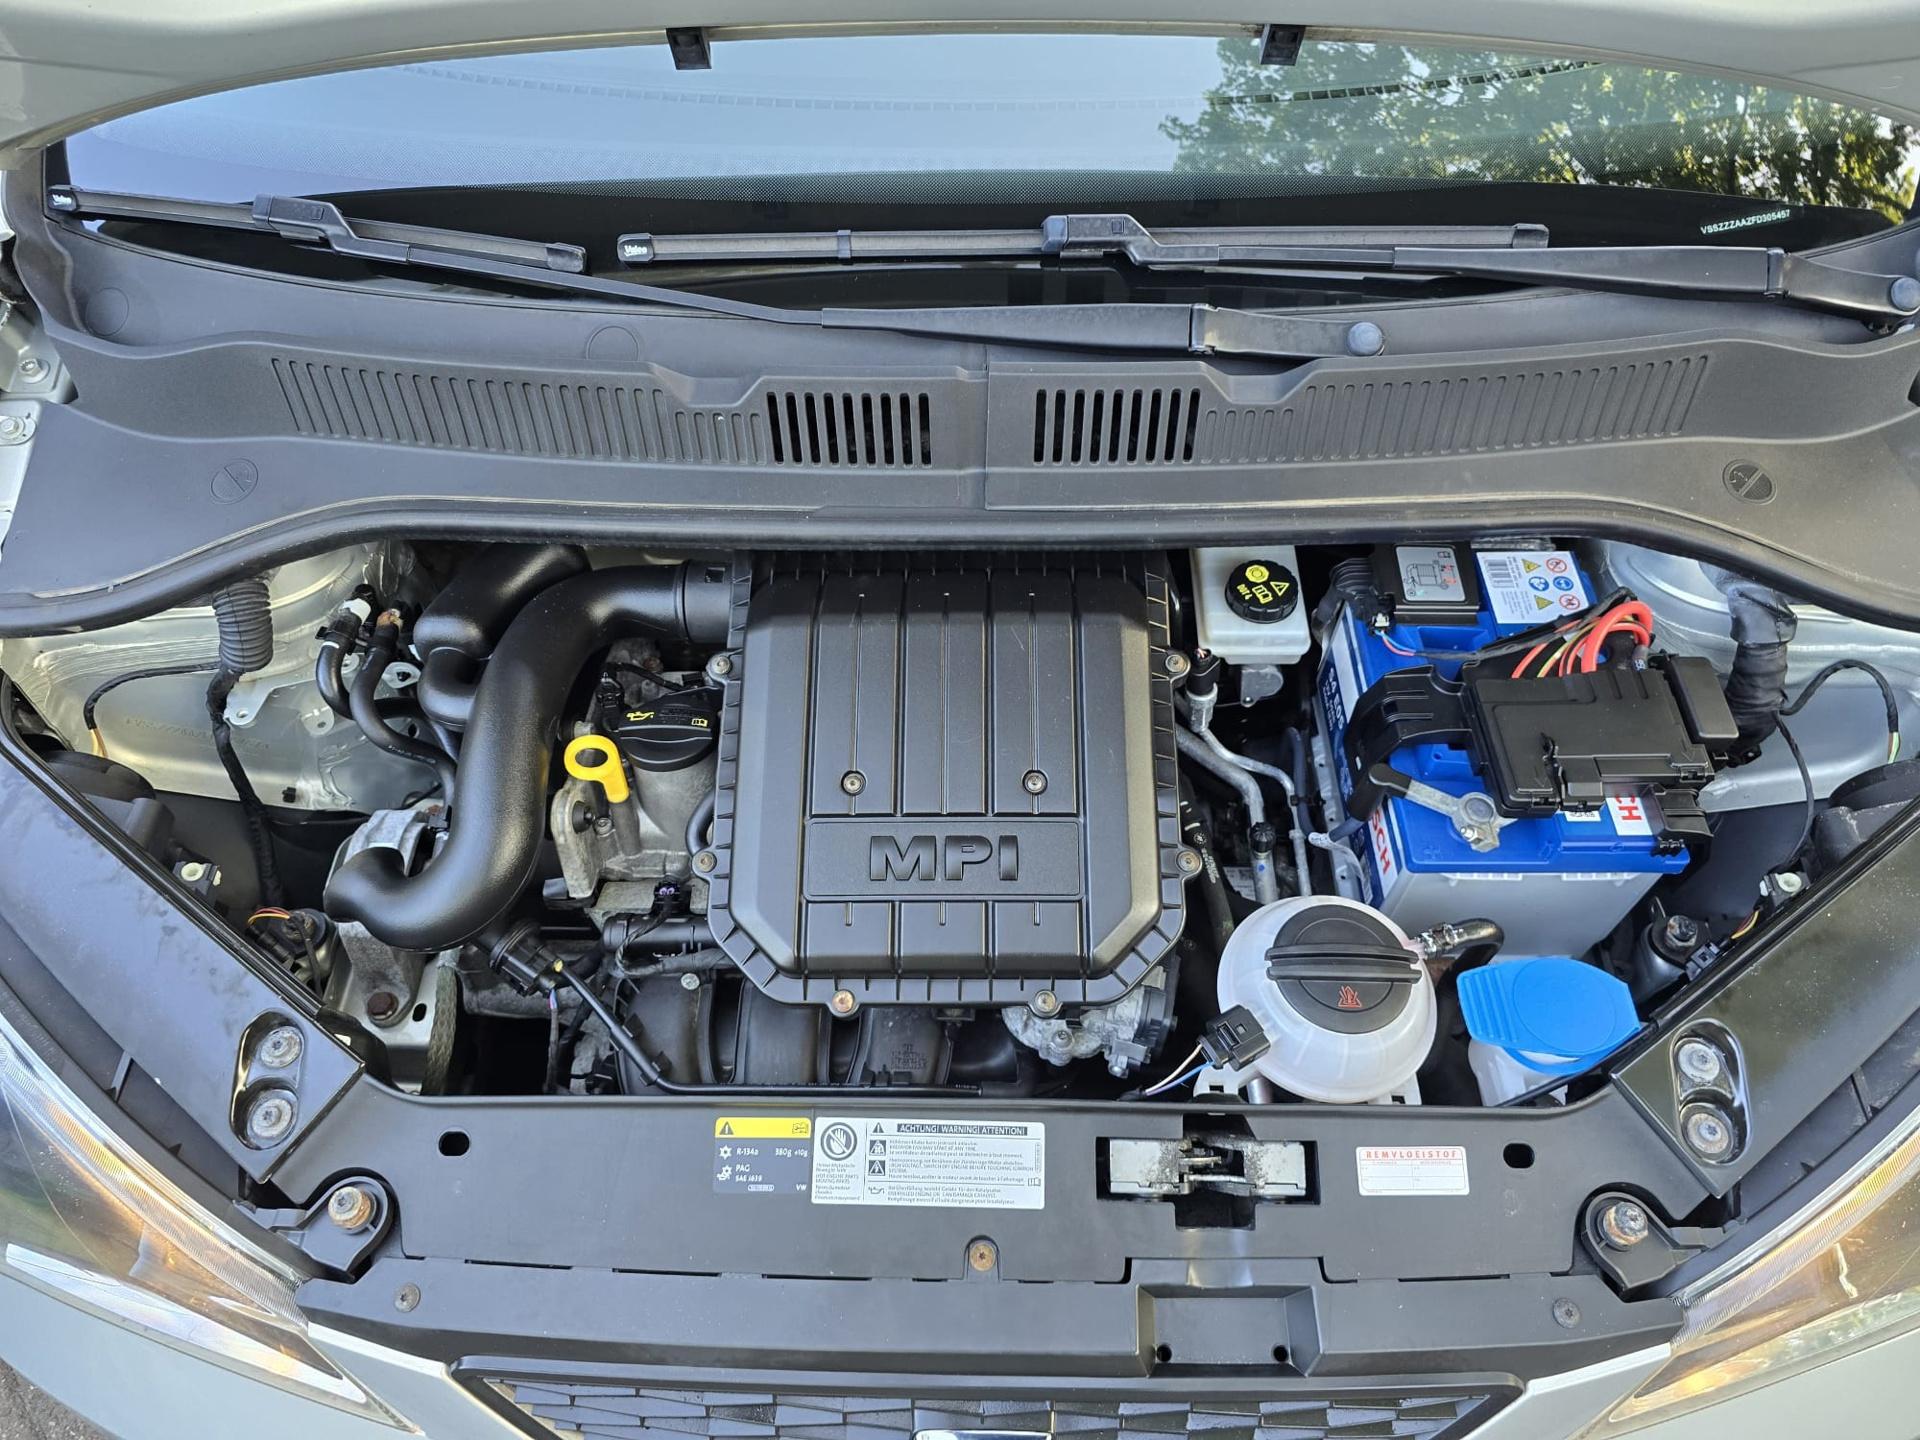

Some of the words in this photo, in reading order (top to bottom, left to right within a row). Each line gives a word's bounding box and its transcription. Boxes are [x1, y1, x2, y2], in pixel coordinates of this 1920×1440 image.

[870, 835, 1019, 881] MPI
[899, 1124, 938, 1134] ACHTUNG!
[941, 1126, 978, 1135] WARNING!
[981, 1127, 1025, 1136] ATTENTION!
[1366, 1150, 1457, 1158] REMVLOEISTOF
